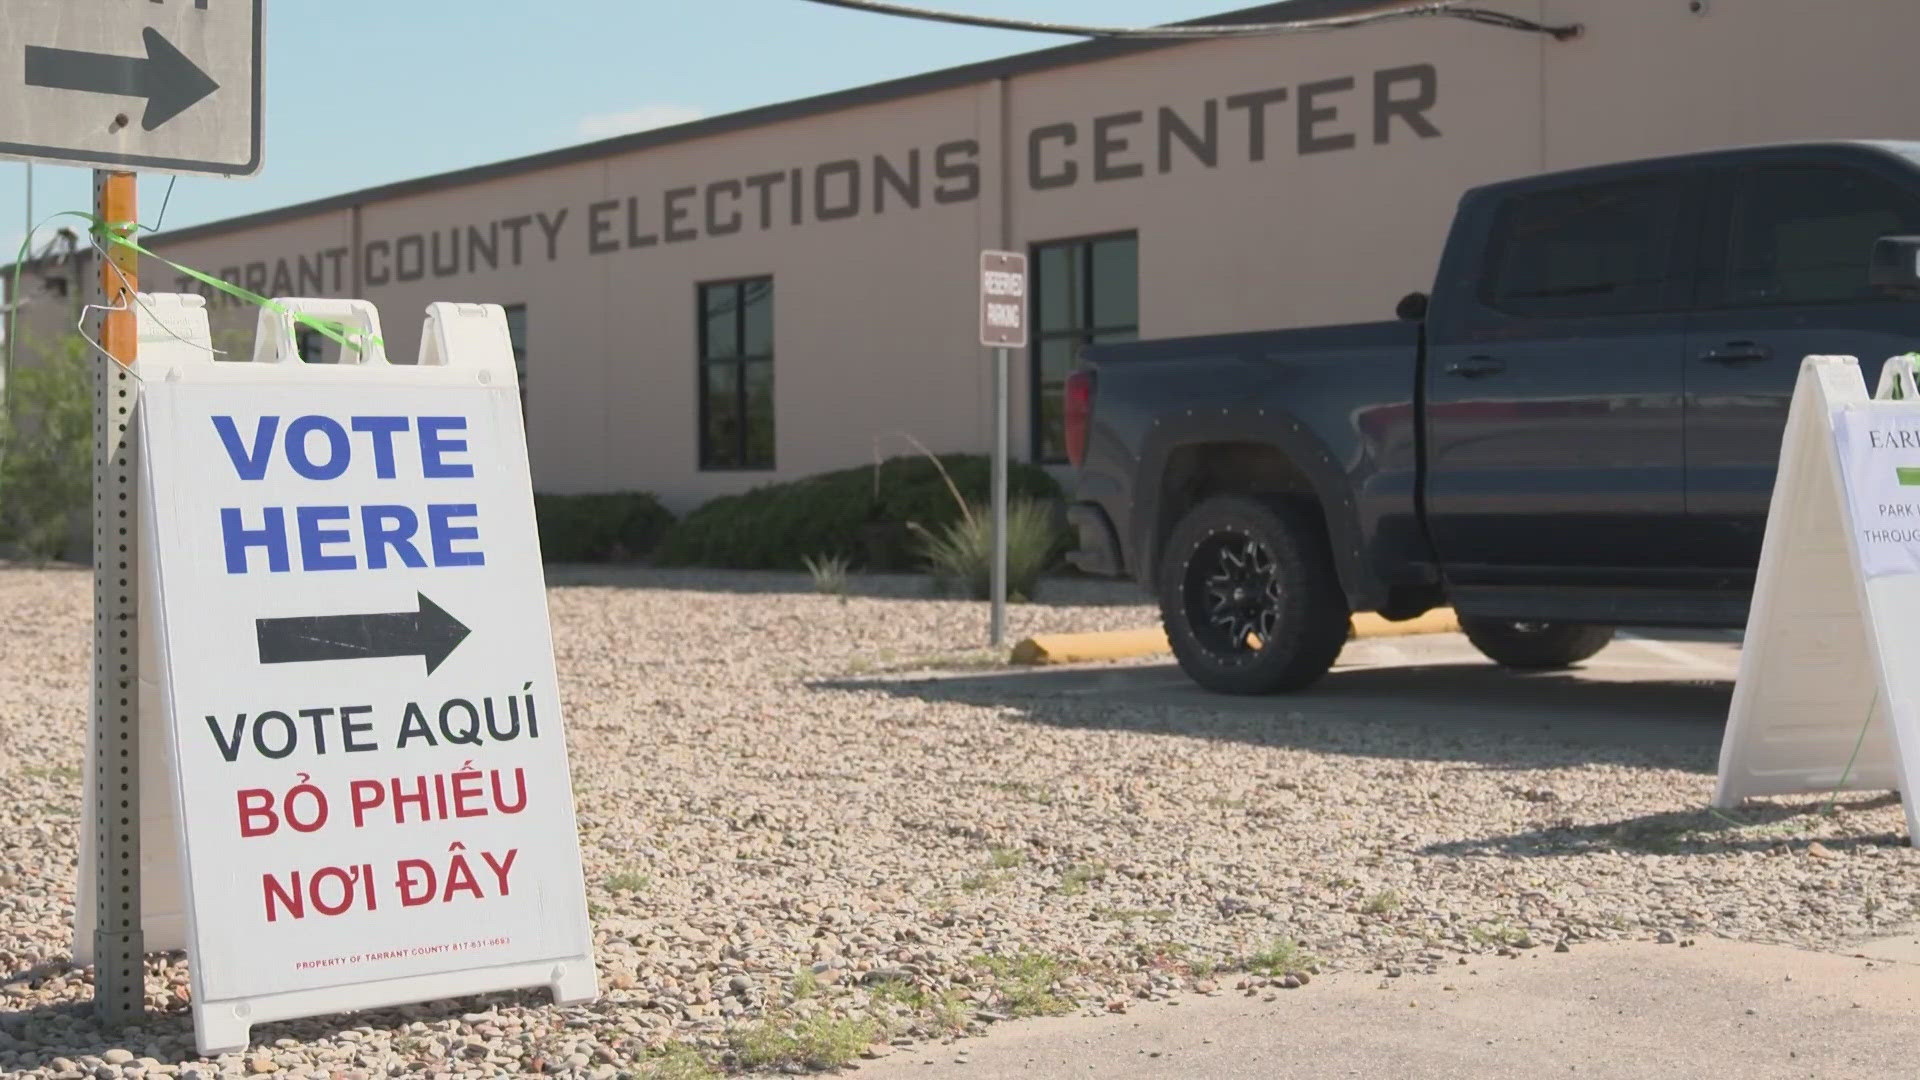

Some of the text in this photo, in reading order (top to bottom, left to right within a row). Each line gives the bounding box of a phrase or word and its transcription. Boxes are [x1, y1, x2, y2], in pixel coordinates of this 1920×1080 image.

[365, 208, 569, 287] COUNTY
[588, 138, 981, 255] ELECTIONS
[1028, 63, 1443, 191] CENTER
[212, 414, 474, 481] VOTE
[221, 502, 485, 575] HERE
[1879, 504, 1913, 517] PARK
[205, 681, 539, 762] VOTE AQUÍ
[237, 760, 528, 838] BỎ PHIẾU
[263, 841, 519, 922] NƠI ĐÂY
[295, 957, 346, 971] PROPERTY
[350, 954, 362, 964] OF
[365, 949, 409, 962] TARRANT
[411, 944, 450, 956] COUNTY
